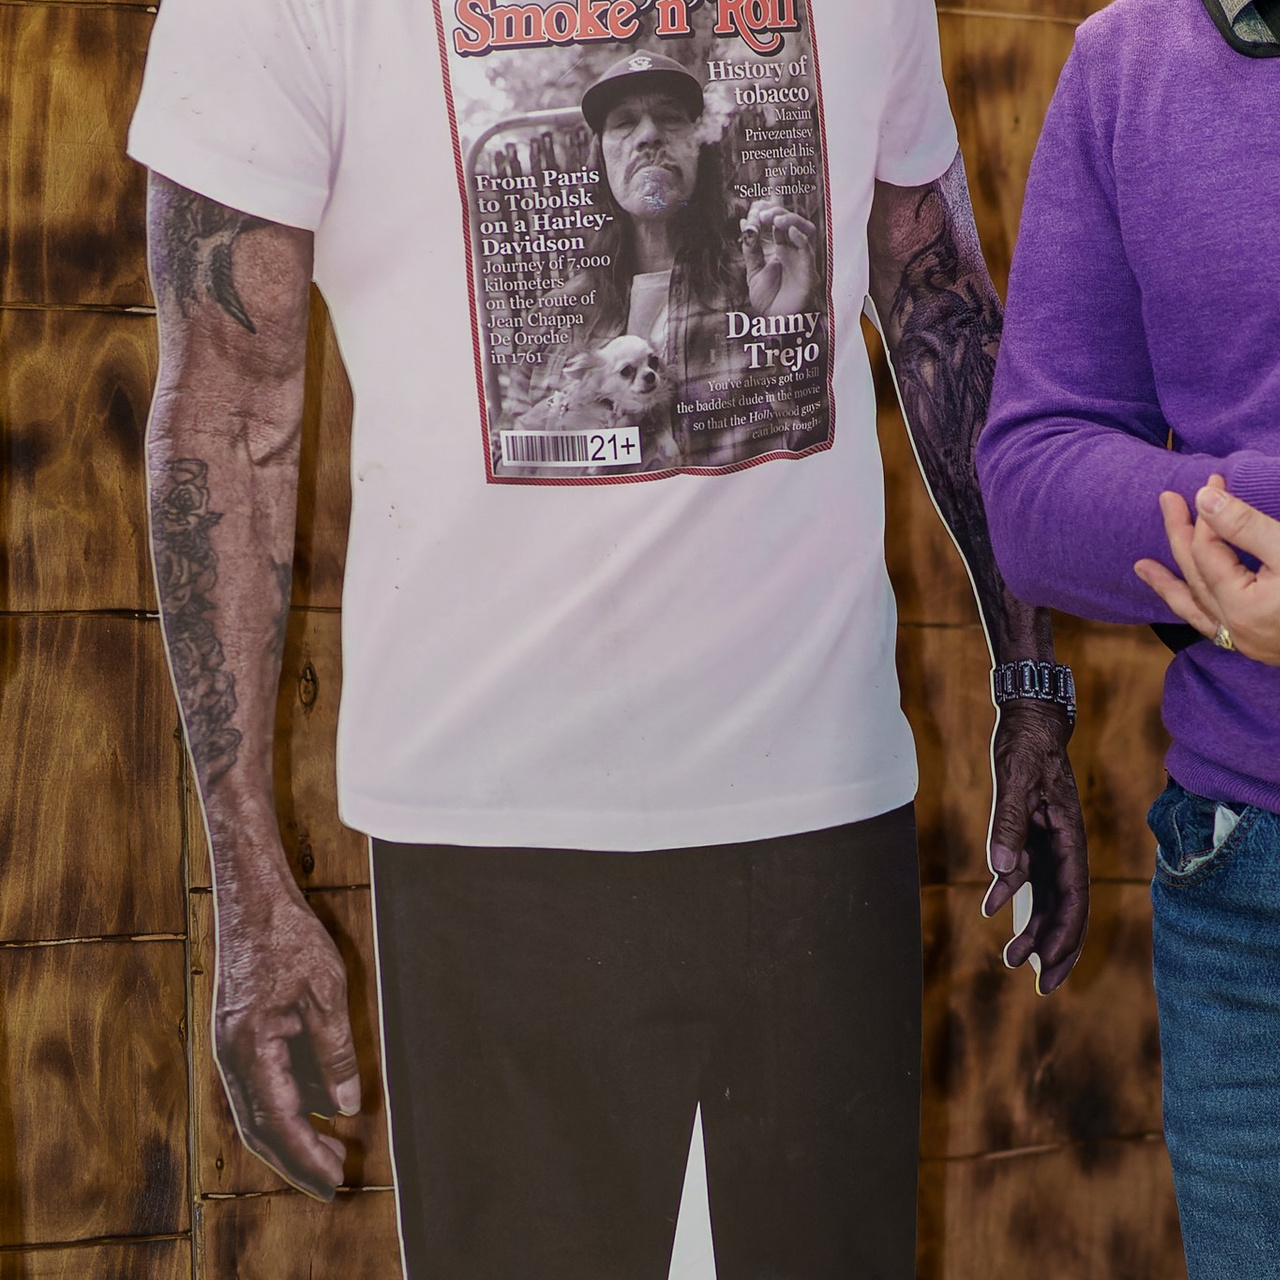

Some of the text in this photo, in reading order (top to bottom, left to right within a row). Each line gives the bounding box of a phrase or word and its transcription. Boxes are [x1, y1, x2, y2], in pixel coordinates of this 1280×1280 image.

[707, 55, 807, 82] History of
[734, 84, 809, 105] tobacco
[775, 108, 811, 121] Maxim
[745, 127, 813, 141] Privezentsev
[741, 144, 814, 163] presented his
[475, 166, 599, 191] From Paris
[765, 162, 816, 177] new book
[733, 183, 772, 197] "Seller
[478, 188, 593, 213] to Tobolsk
[480, 210, 613, 234] on a Harley-
[482, 236, 585, 256] Davidson
[483, 255, 610, 274] Journey of 7,000
[485, 277, 564, 292] kilometers
[486, 290, 596, 309] on the route of
[488, 313, 584, 328] Jean Chappa
[726, 311, 820, 338] Danny
[490, 330, 568, 346] De Oroche
[491, 350, 542, 366] in 1761
[744, 337, 819, 371] Trejo
[708, 367, 819, 391] You've always got to kill
[677, 385, 820, 414] the baddest dude in the movie
[693, 402, 821, 431] so that the Hollywood guys
[752, 429, 768, 439] can
[770, 422, 790, 434] look
[590, 434, 635, 461] 21+
